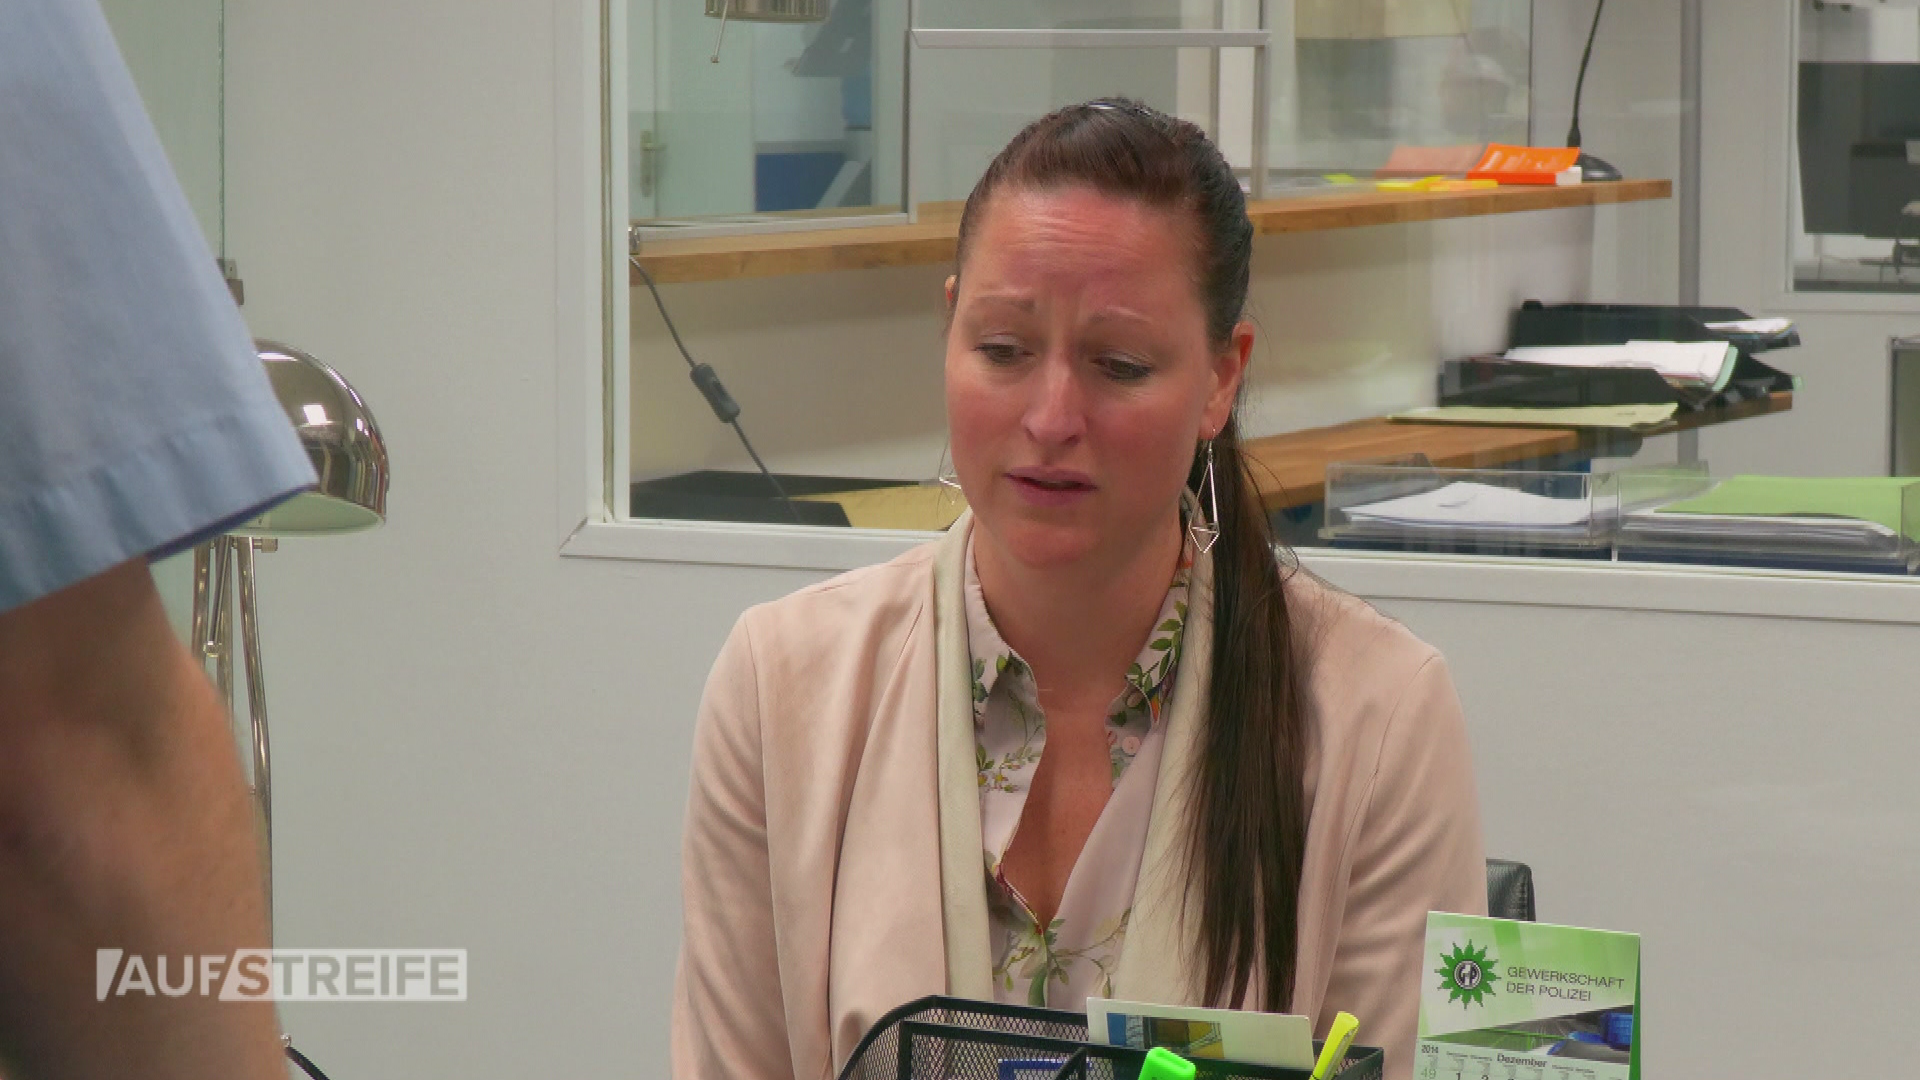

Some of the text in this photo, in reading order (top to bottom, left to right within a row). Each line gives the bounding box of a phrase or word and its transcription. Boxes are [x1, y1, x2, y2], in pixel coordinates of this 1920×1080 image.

[1507, 966, 1625, 990] GEWERKSCHAFT
[1506, 981, 1592, 1002] DER POLIZEI
[1421, 1044, 1439, 1054] 2014
[1497, 1053, 1547, 1068] Dezember
